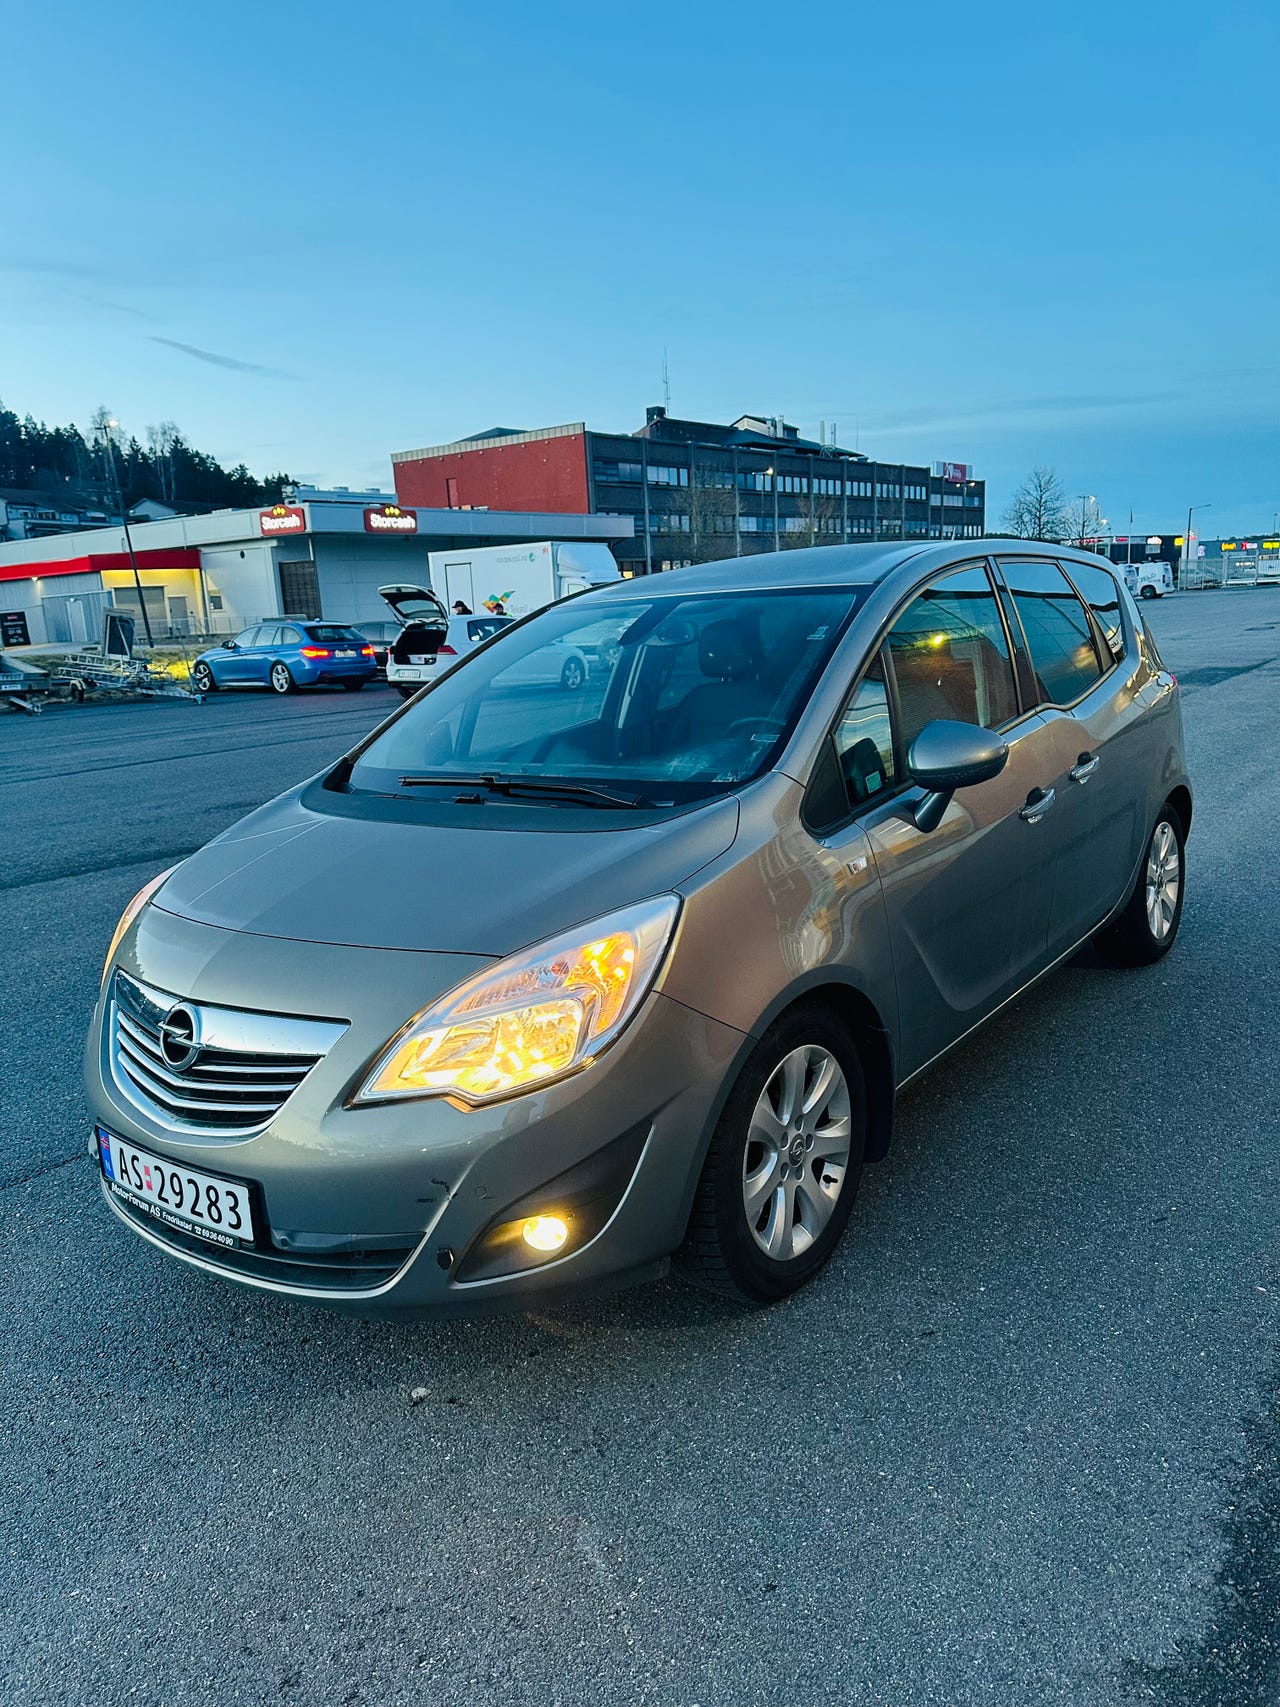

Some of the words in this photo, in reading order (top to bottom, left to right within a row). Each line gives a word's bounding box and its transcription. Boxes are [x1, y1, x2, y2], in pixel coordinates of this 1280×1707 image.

[369, 514, 416, 529] Storcash
[119, 1147, 144, 1191] AS
[154, 1165, 242, 1230] 29283
[149, 1203, 161, 1218] AS
[162, 1211, 193, 1231] Fredrikstad
